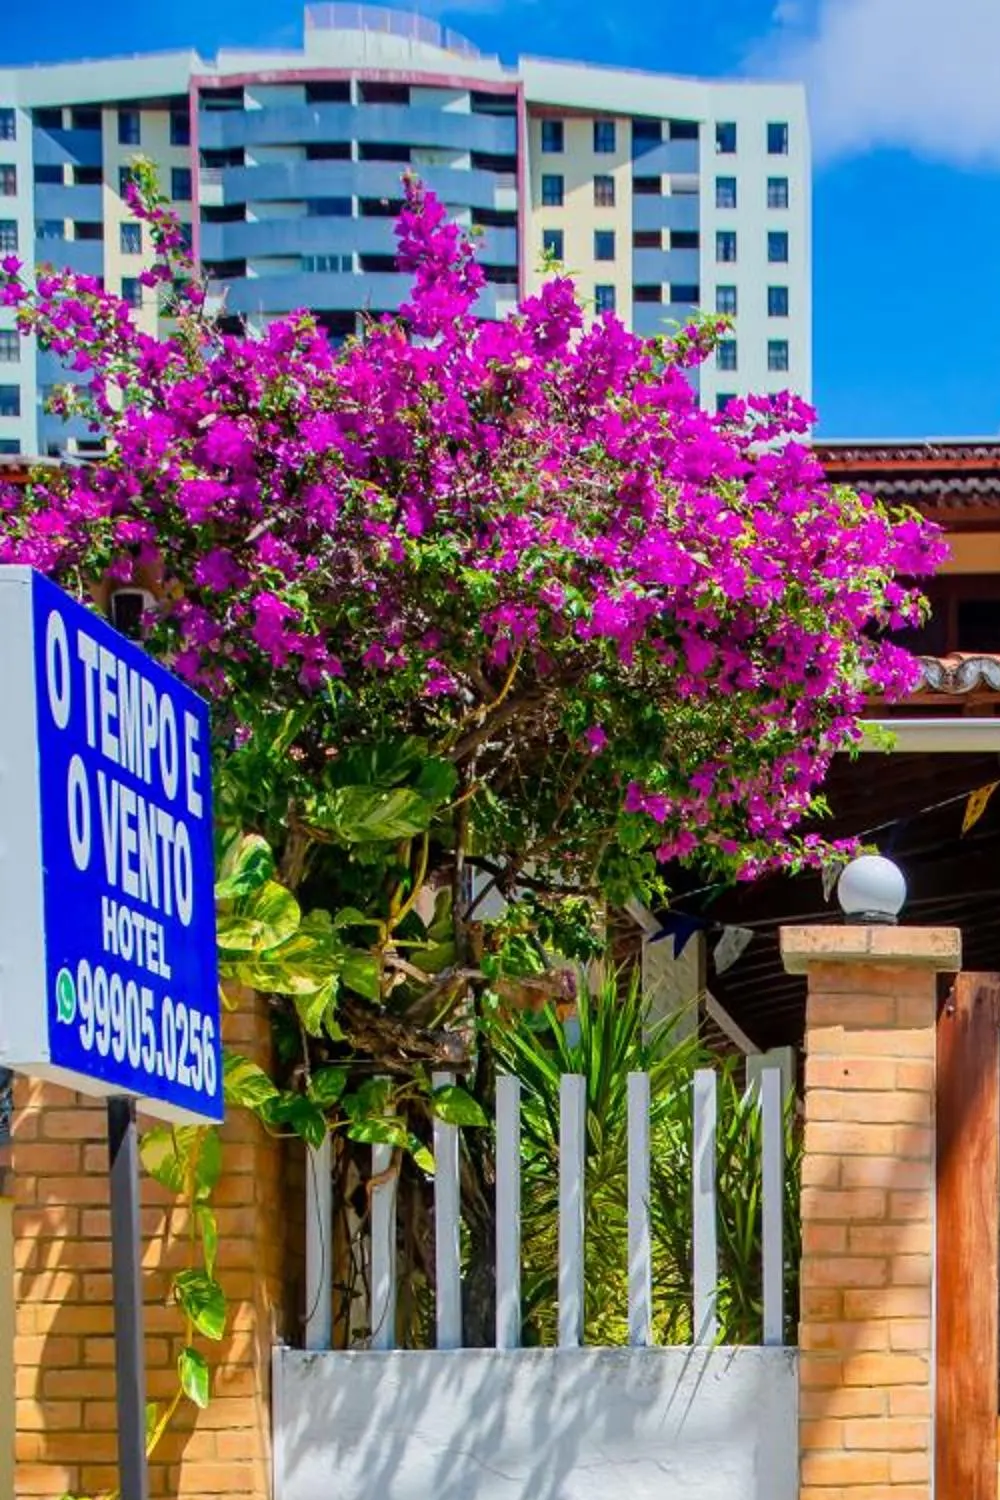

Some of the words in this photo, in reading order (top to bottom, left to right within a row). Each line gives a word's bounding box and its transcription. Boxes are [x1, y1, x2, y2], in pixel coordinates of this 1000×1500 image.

[46, 609, 71, 730] O
[77, 629, 179, 801] TEMPO
[184, 710, 203, 819] E
[67, 753, 91, 871] O
[97, 769, 193, 927] VENTO
[102, 895, 172, 980] HOTEL
[77, 959, 217, 1097] 99905.0256
